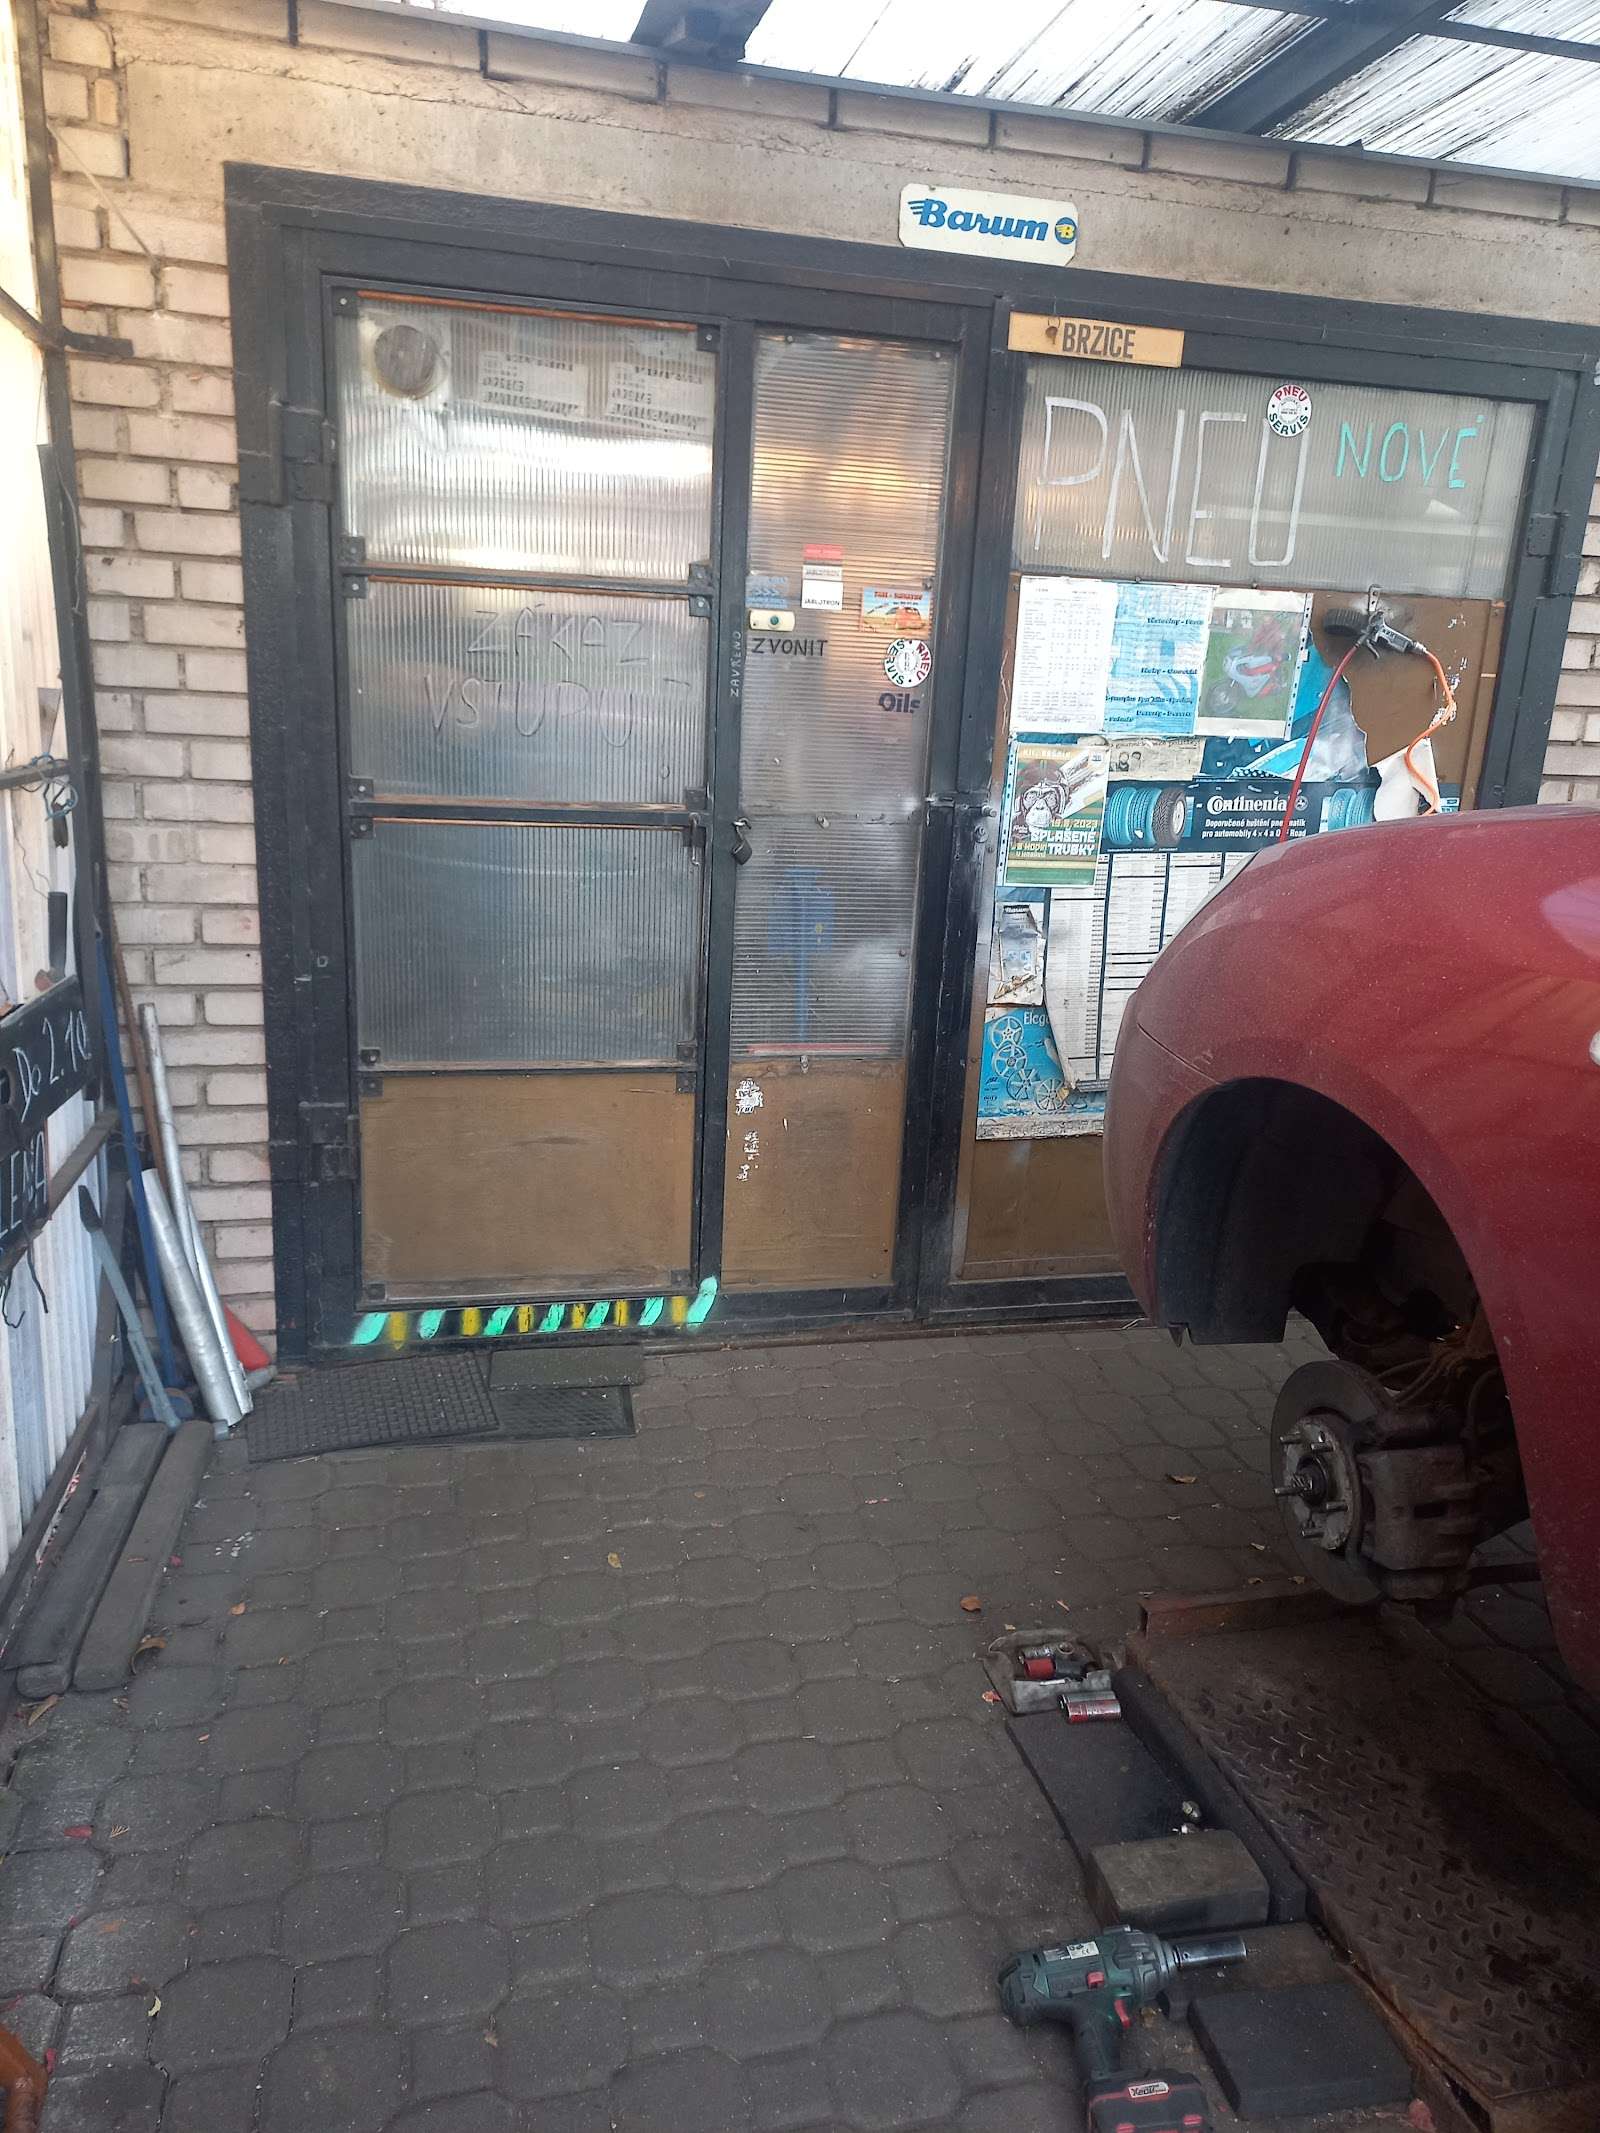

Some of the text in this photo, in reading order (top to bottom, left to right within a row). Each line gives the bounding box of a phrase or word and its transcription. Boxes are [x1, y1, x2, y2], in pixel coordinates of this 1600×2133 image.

[908, 198, 1049, 242] Barum
[1062, 321, 1136, 360] BRZICE
[1274, 385, 1307, 402] PNEU
[1269, 412, 1309, 435] SERVIS
[1034, 397, 1310, 568] PNEU
[752, 637, 829, 657] ZVONIT
[730, 631, 743, 698] ZAVŘENO
[886, 639, 906, 685] SERVIS
[423, 674, 634, 748] VSTUPU
[1206, 794, 1291, 815] Continenta
[1201, 831, 1213, 839] pro
[1214, 829, 1251, 839] automobily
[1205, 819, 1244, 828] Doporučené
[1246, 819, 1269, 827] huštění
[1029, 827, 1098, 843] SPLAŠENÉ
[1047, 843, 1096, 856] TRUBKY
